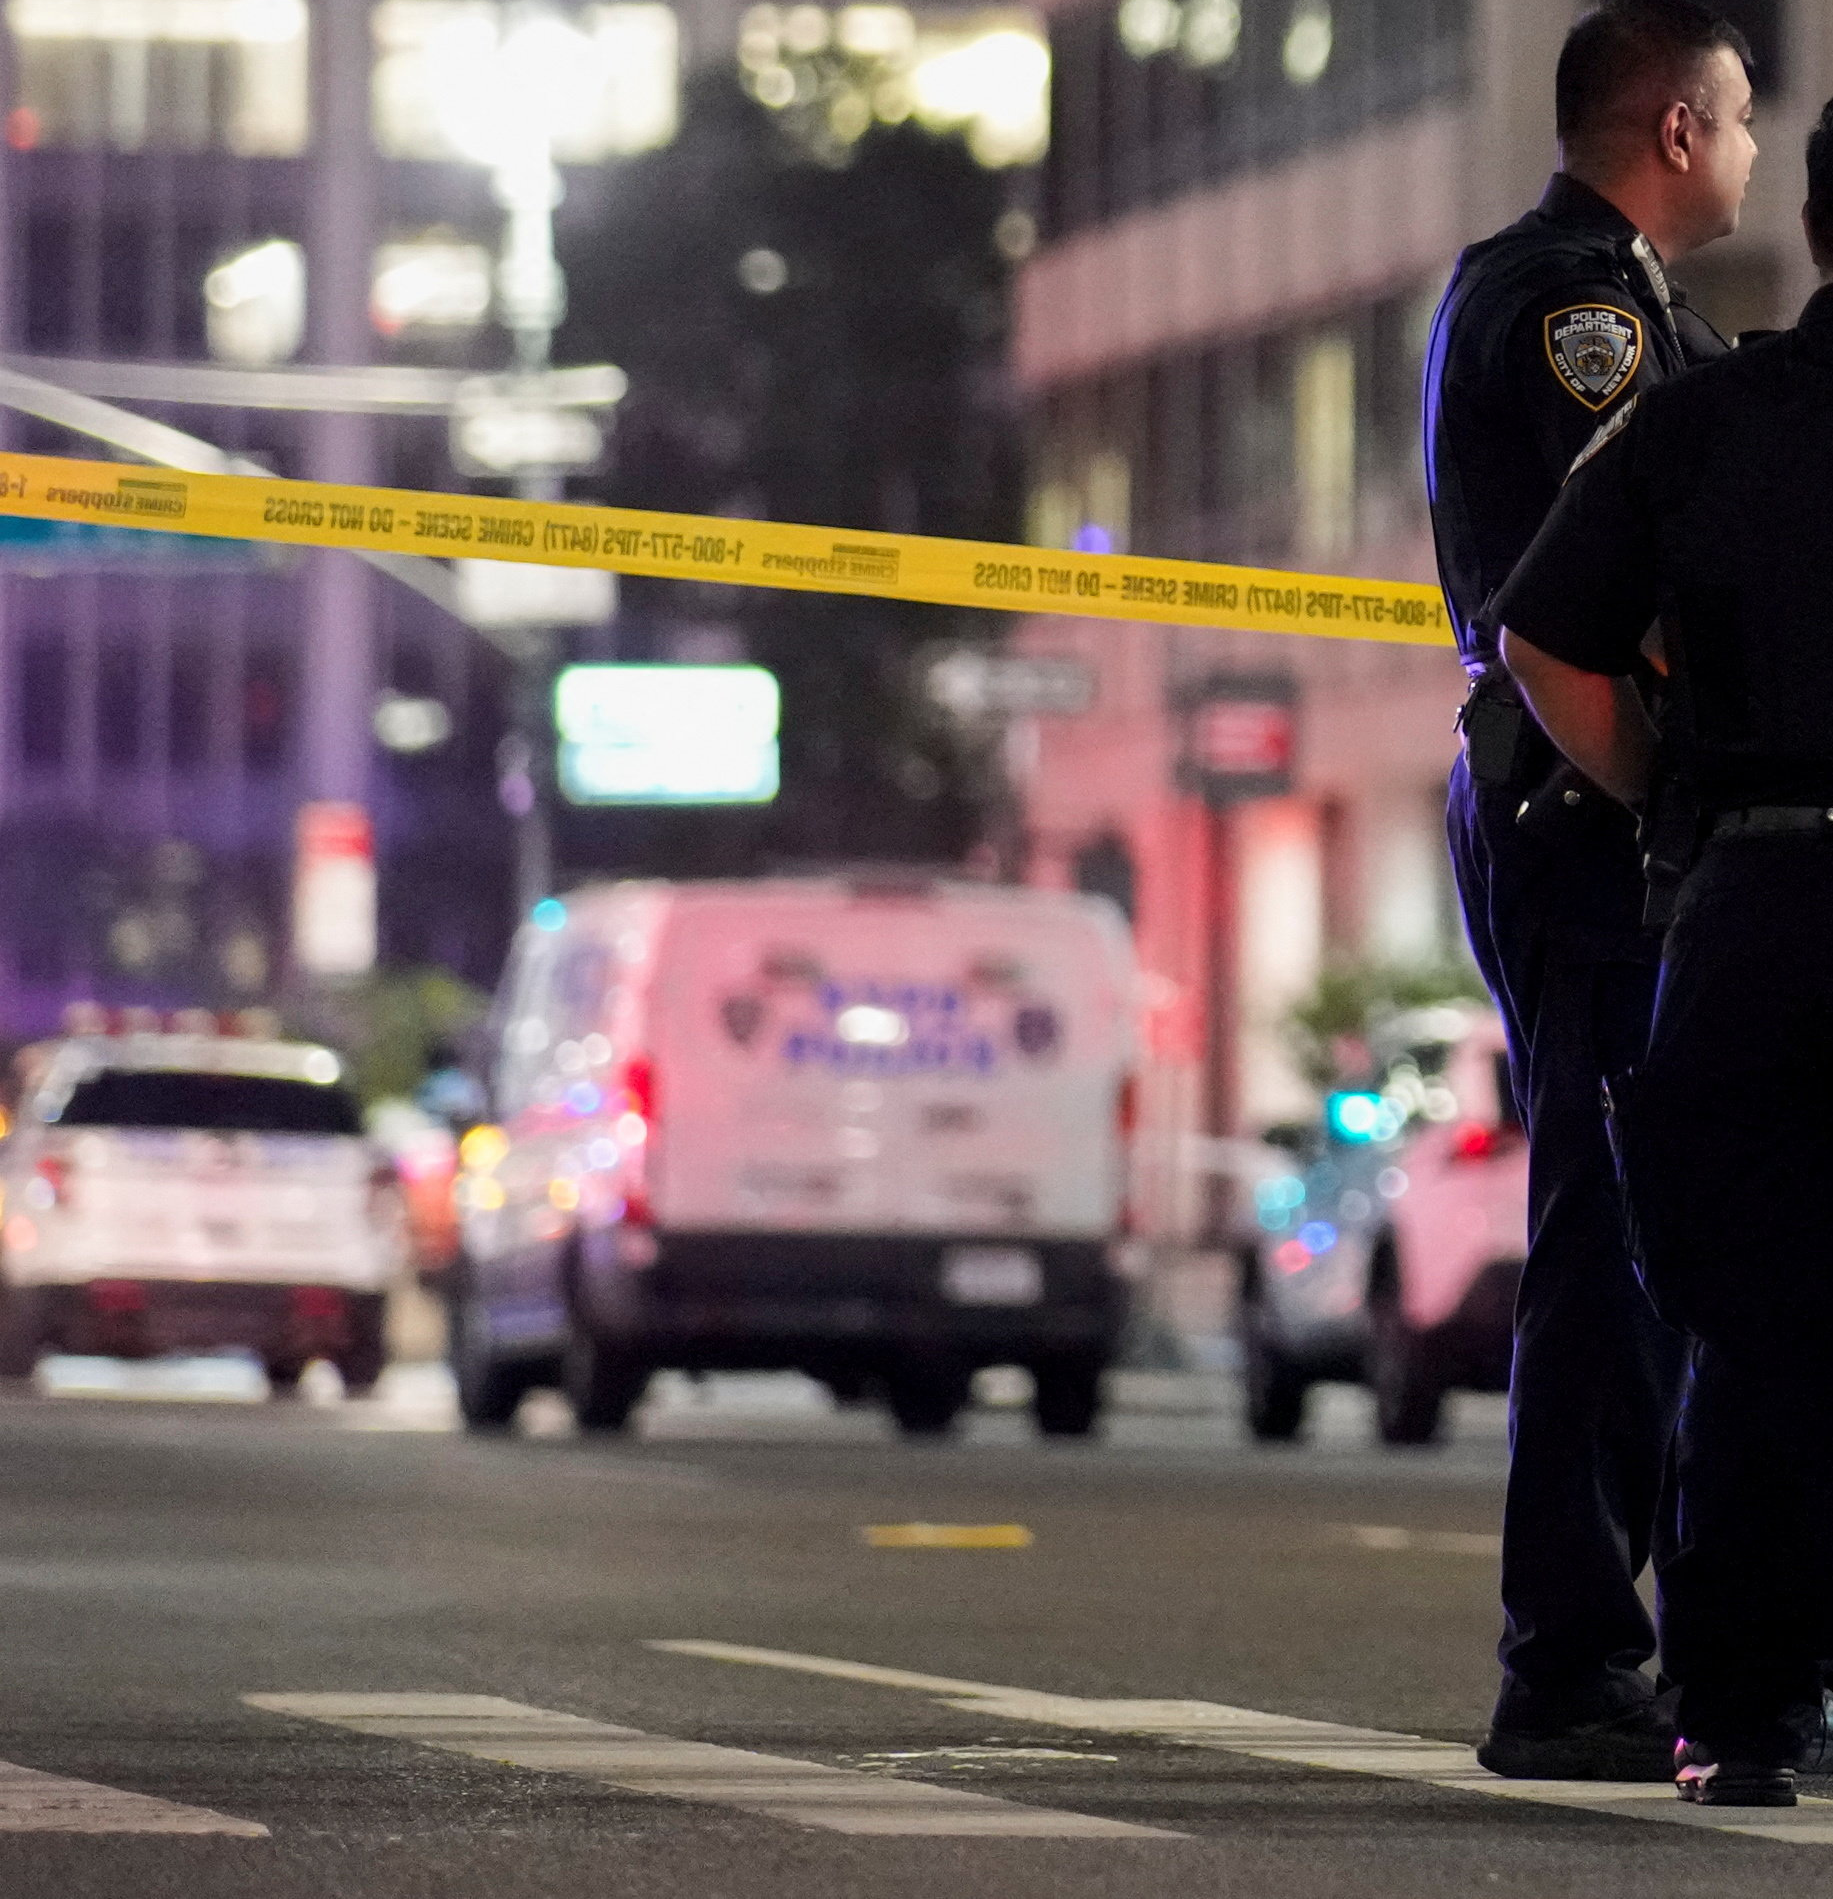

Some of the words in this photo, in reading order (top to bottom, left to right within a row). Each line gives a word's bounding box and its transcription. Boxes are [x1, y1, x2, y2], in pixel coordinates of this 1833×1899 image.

[1554, 321, 1632, 341] DEPARTMENT
[1570, 311, 1616, 324] POLICE
[1555, 352, 1574, 377] CITY
[1570, 378, 1586, 392] OF
[1602, 372, 1622, 396] NEW
[1618, 345, 1636, 373] YORK
